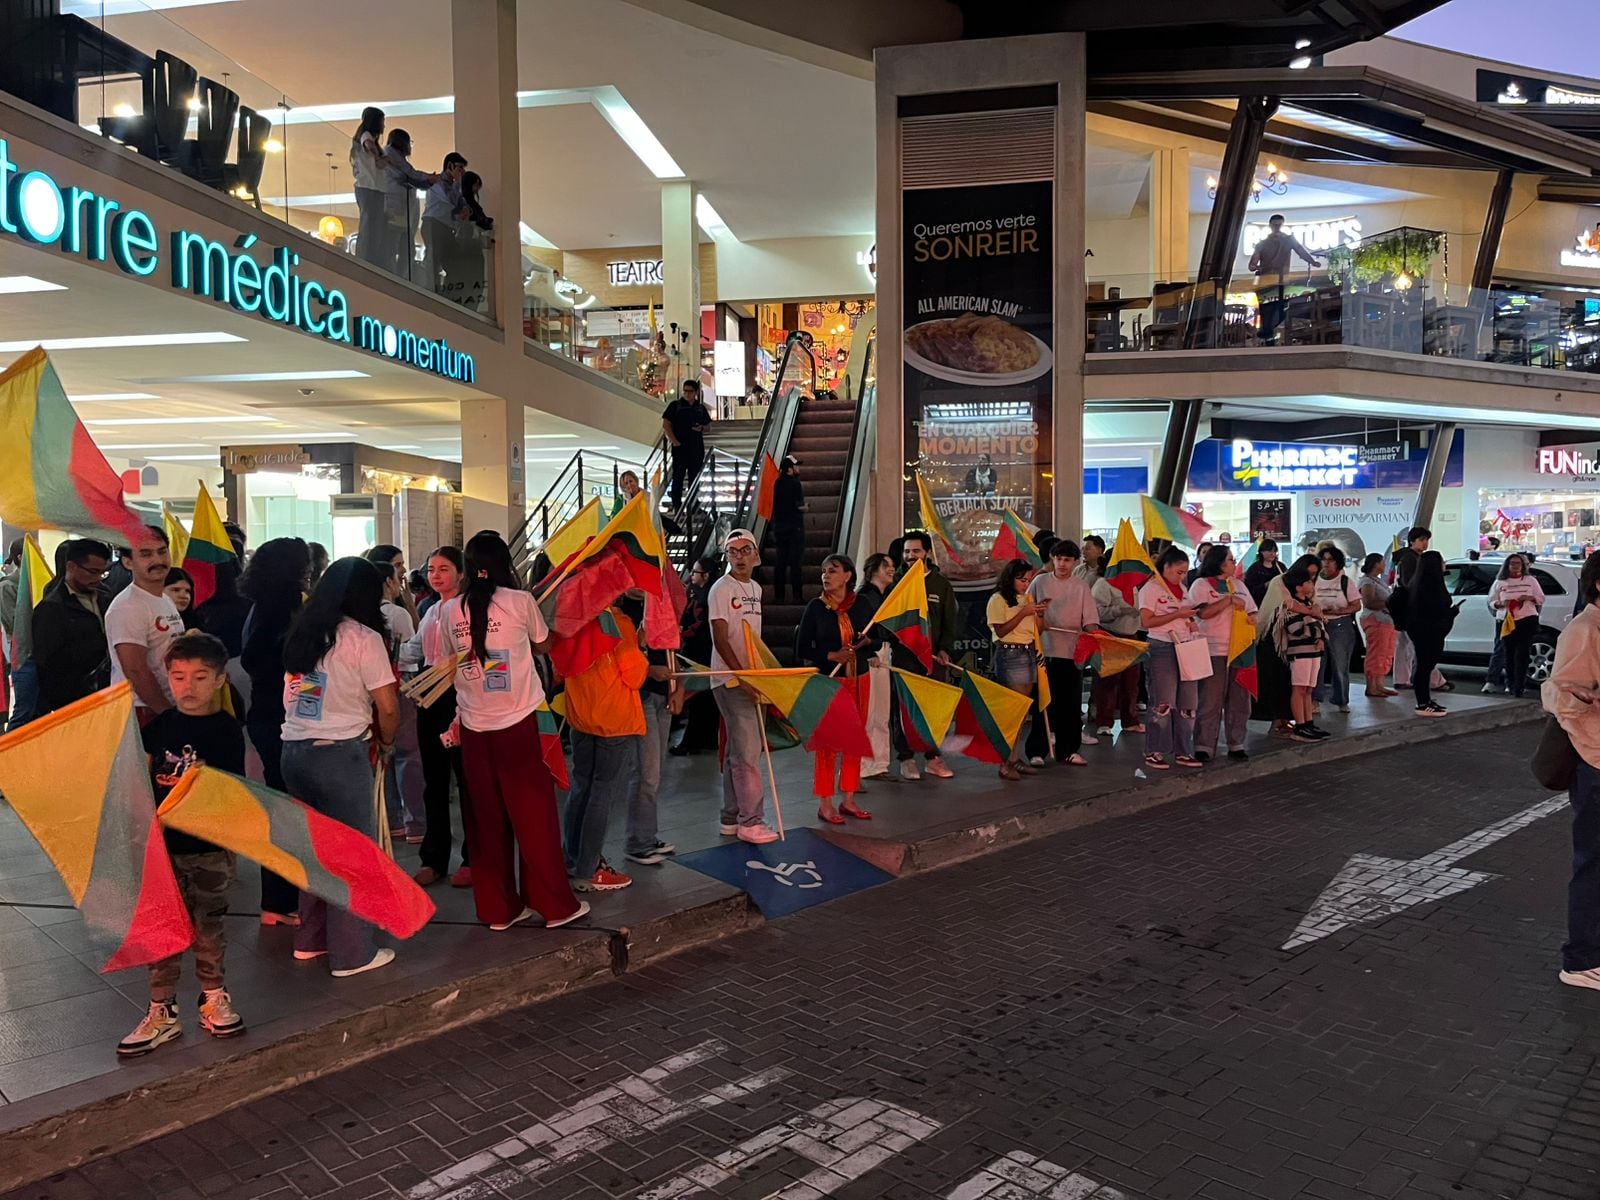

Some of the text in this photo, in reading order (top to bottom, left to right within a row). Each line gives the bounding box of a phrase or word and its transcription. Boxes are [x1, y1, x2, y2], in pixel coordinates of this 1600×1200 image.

[913, 213, 1036, 240] Queremos verte
[914, 225, 1040, 262] SONREÍR
[1243, 218, 1362, 256] BTON'S
[0, 138, 474, 383] torre médica momentum
[918, 298, 936, 314] ALL
[937, 295, 990, 312] AMERICAN
[918, 421, 1040, 438] EN CUALQUIER
[919, 436, 1039, 455] MOMENTO
[1257, 501, 1284, 510] SALE
[1323, 498, 1360, 507] VISION
[1306, 512, 1410, 524] EMPORIO ARMANI
